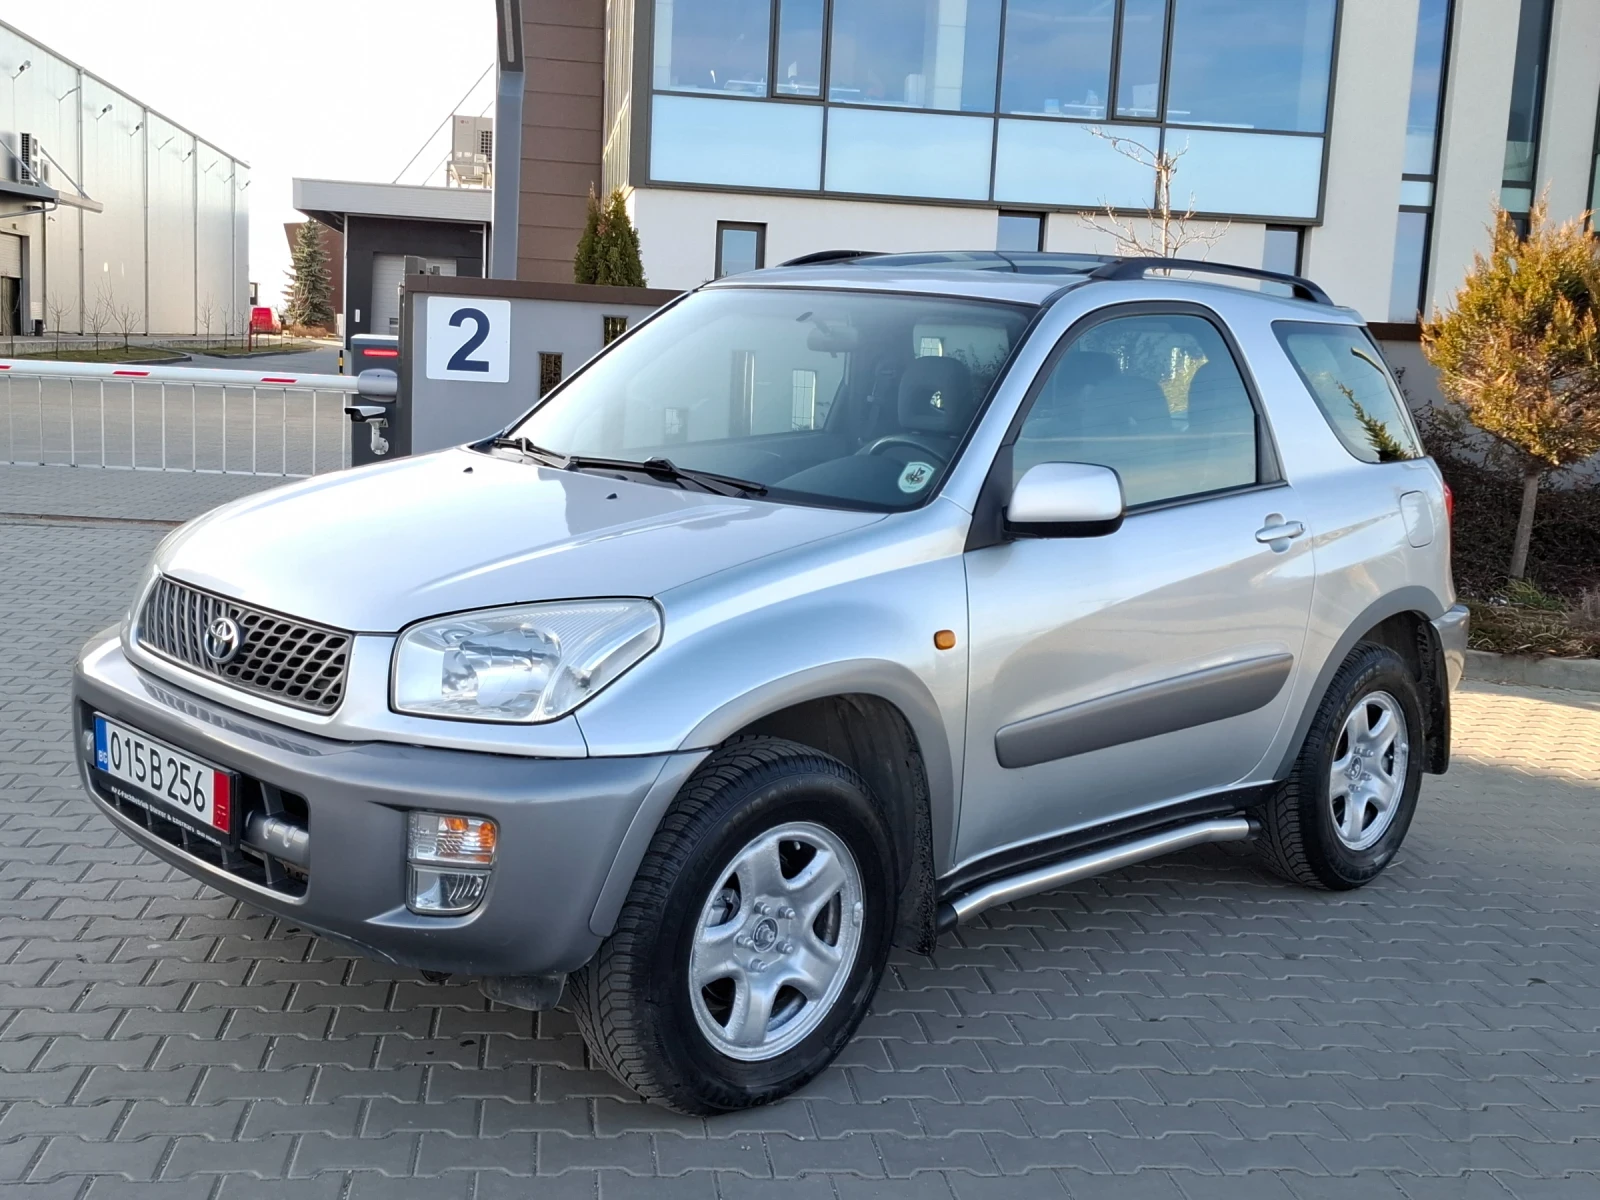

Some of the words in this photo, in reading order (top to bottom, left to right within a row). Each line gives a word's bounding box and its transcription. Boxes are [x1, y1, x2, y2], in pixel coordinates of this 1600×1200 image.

[446, 307, 490, 373] 2
[98, 750, 107, 764] BG
[111, 731, 205, 813] 015B256
